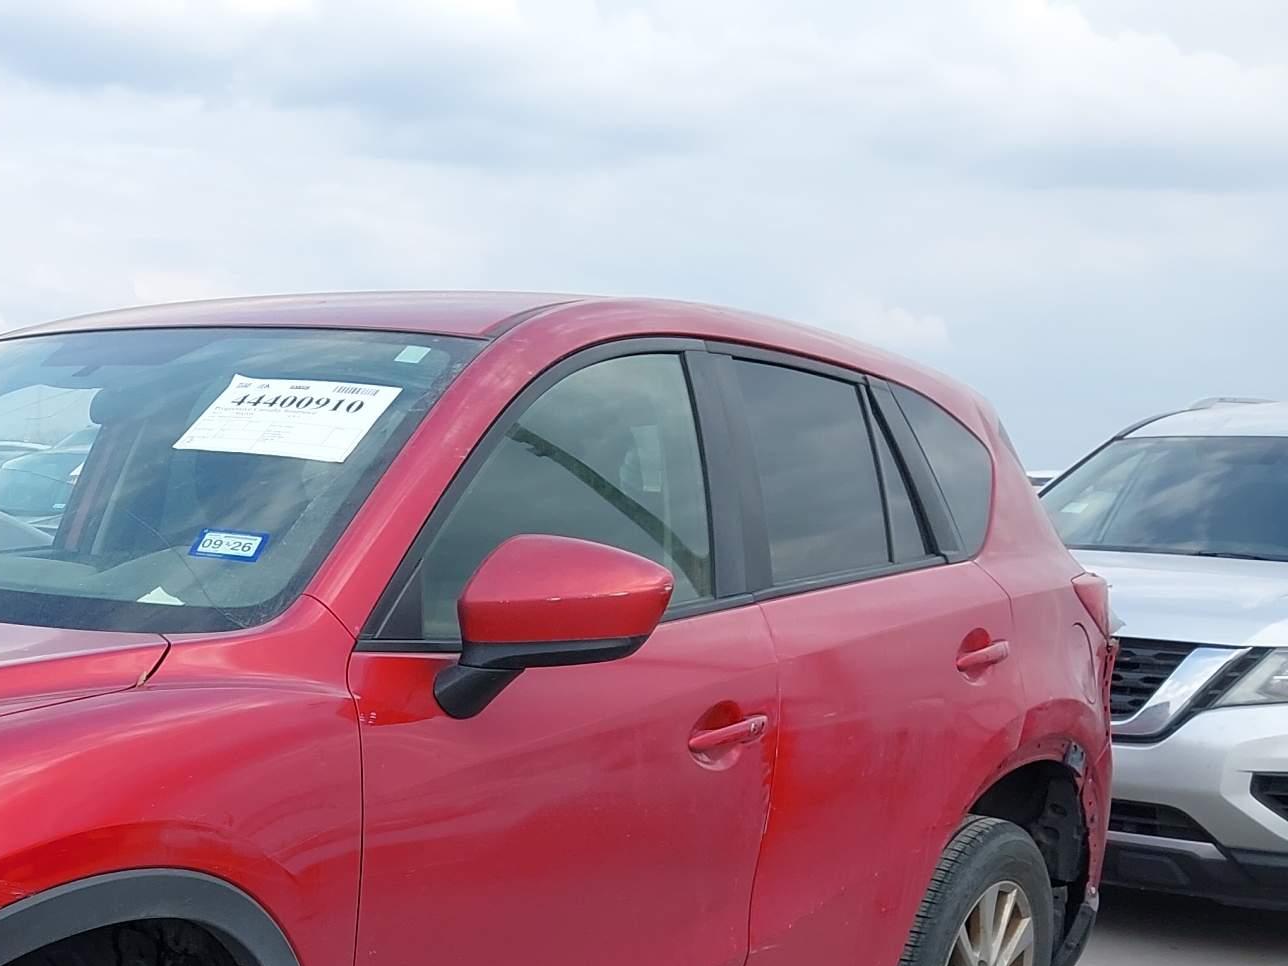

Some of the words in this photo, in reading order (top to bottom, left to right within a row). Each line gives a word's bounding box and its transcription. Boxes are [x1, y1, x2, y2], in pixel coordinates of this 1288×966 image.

[231, 393, 365, 414] 44400910
[201, 538, 223, 550] 09
[230, 541, 253, 552] 26
